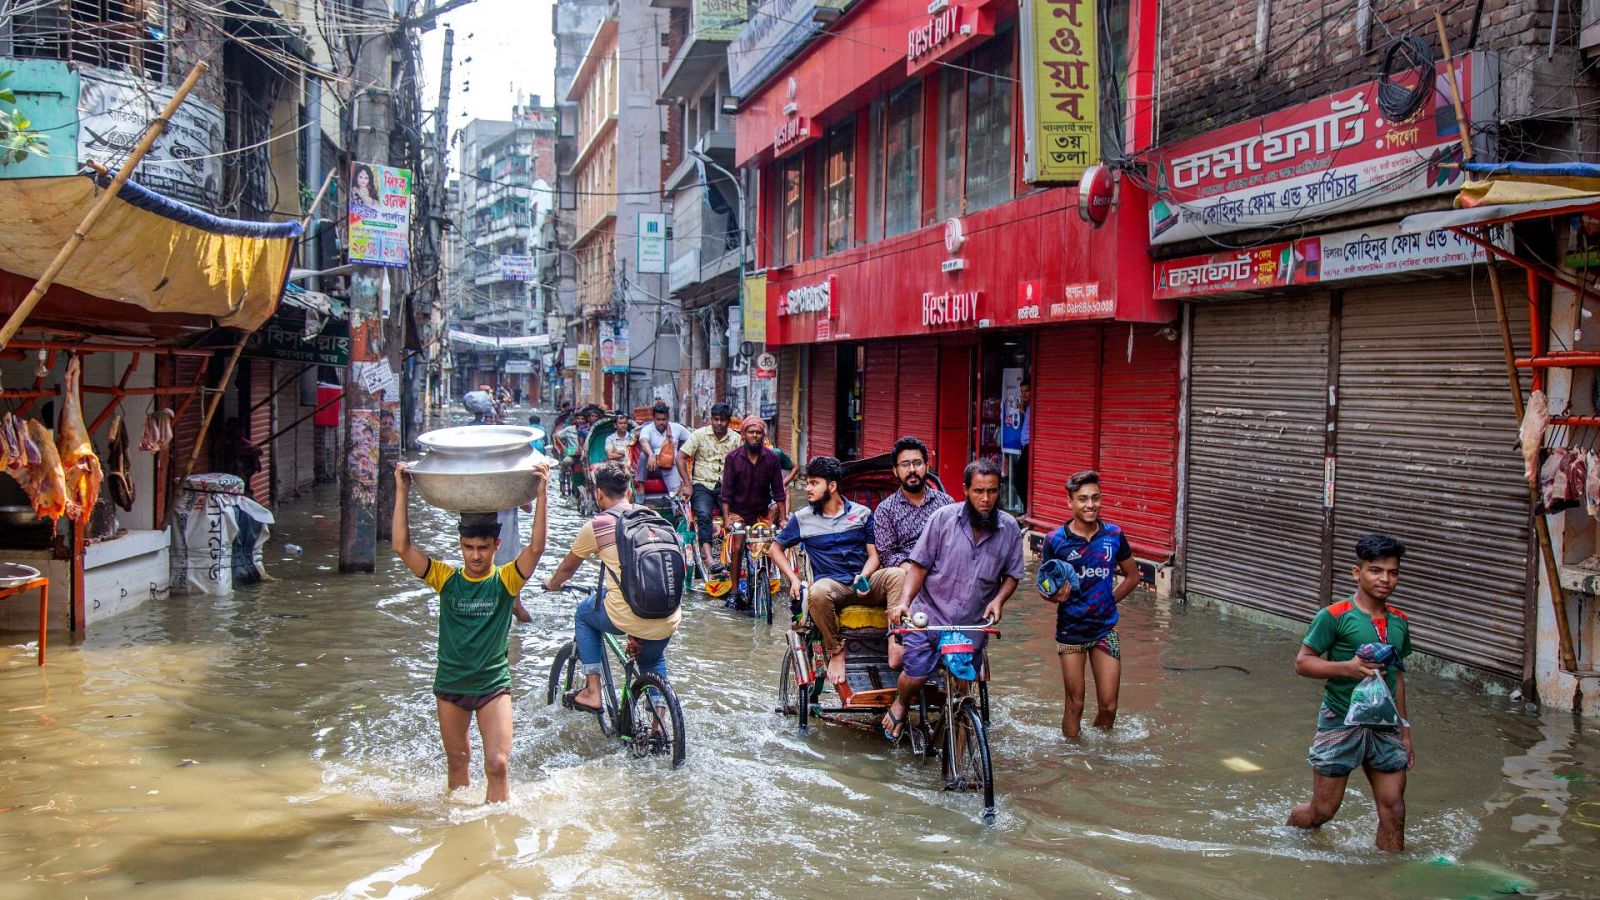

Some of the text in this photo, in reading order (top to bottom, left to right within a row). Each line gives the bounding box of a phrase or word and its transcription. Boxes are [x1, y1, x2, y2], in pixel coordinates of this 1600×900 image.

[1054, 136, 1083, 149] ৩য়
[1171, 91, 1369, 189] কমফোর্ট
[1385, 127, 1419, 149] পিলো
[1049, 150, 1088, 165] তলা
[1202, 196, 1244, 225] কোহিনুর
[1249, 190, 1275, 215] ফোম
[1280, 189, 1302, 211] এন্ড
[1343, 234, 1387, 262] কোহিনুর
[1392, 232, 1421, 255] ফোম
[1426, 229, 1448, 250] এন্ড
[1168, 252, 1252, 287] কমফোর্ট
[319, 353, 338, 363] ঘর
[1076, 566, 1110, 579] Jeep
